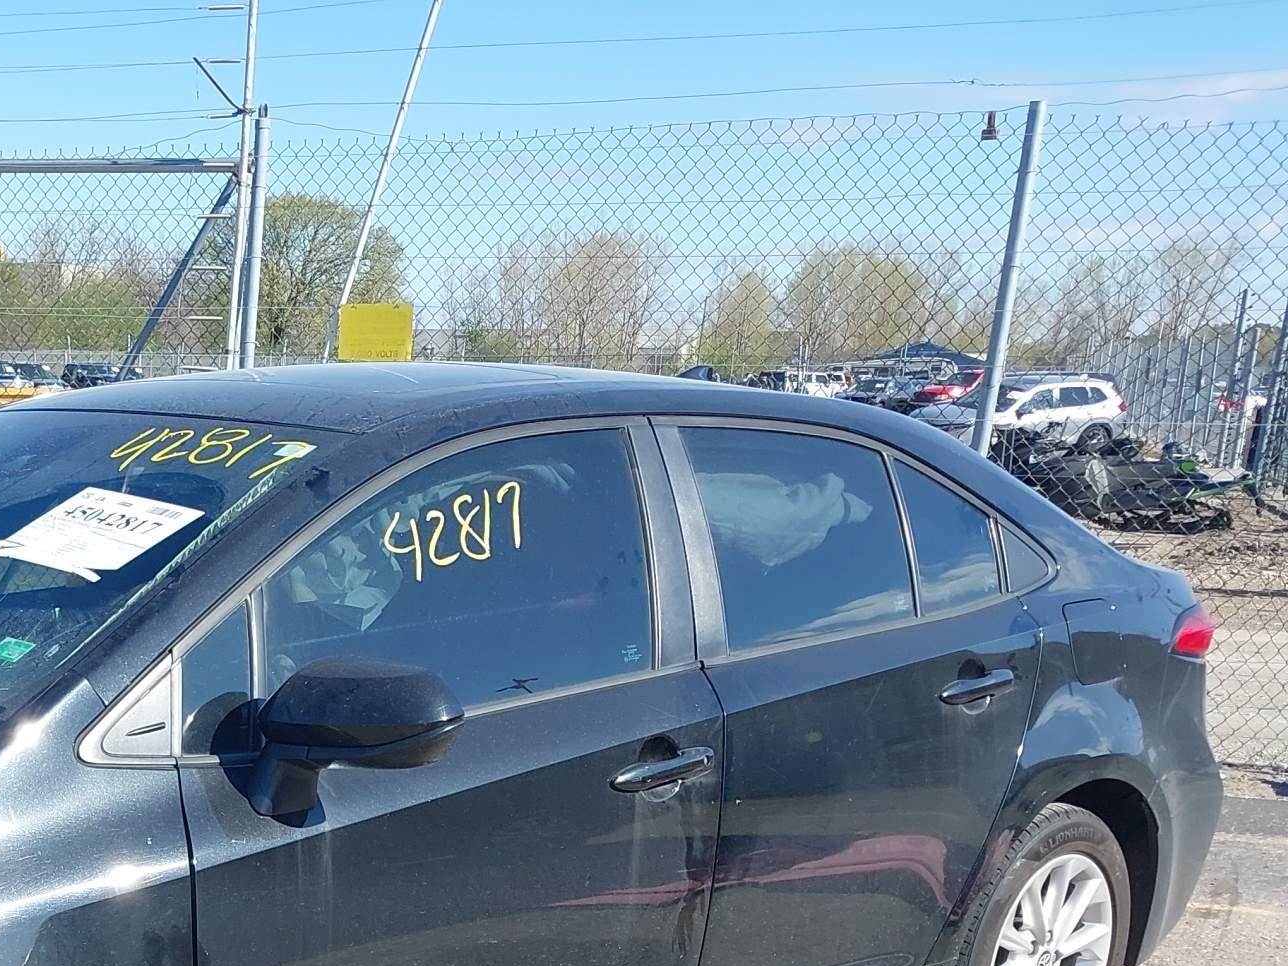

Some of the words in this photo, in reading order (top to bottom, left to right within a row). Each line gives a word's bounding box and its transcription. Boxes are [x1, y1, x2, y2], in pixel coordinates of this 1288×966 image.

[110, 427, 311, 480] 42817
[64, 505, 164, 535] 45042817
[383, 481, 521, 582] 42817
